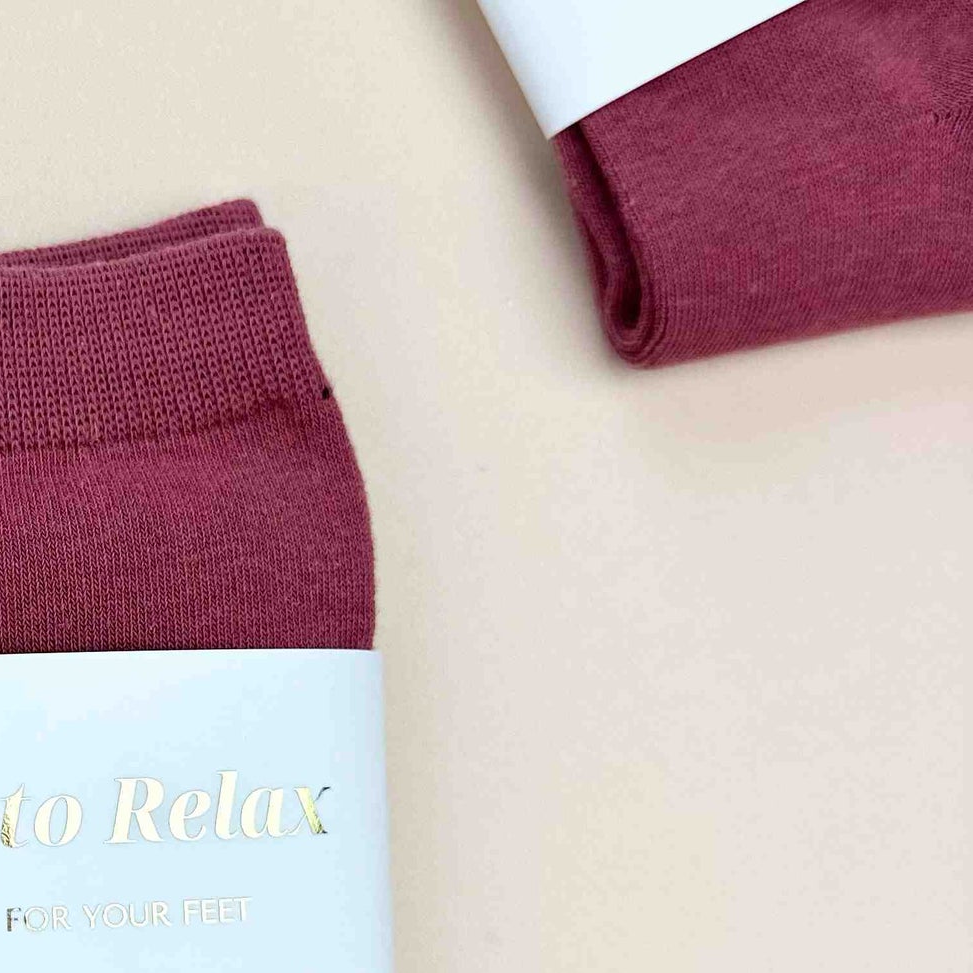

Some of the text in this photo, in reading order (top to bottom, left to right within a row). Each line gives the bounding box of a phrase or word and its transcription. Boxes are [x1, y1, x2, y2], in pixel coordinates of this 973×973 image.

[104, 769, 331, 846] Relax
[5, 905, 72, 933] FOR
[82, 900, 172, 930] YOUR
[182, 895, 253, 926] FEET
